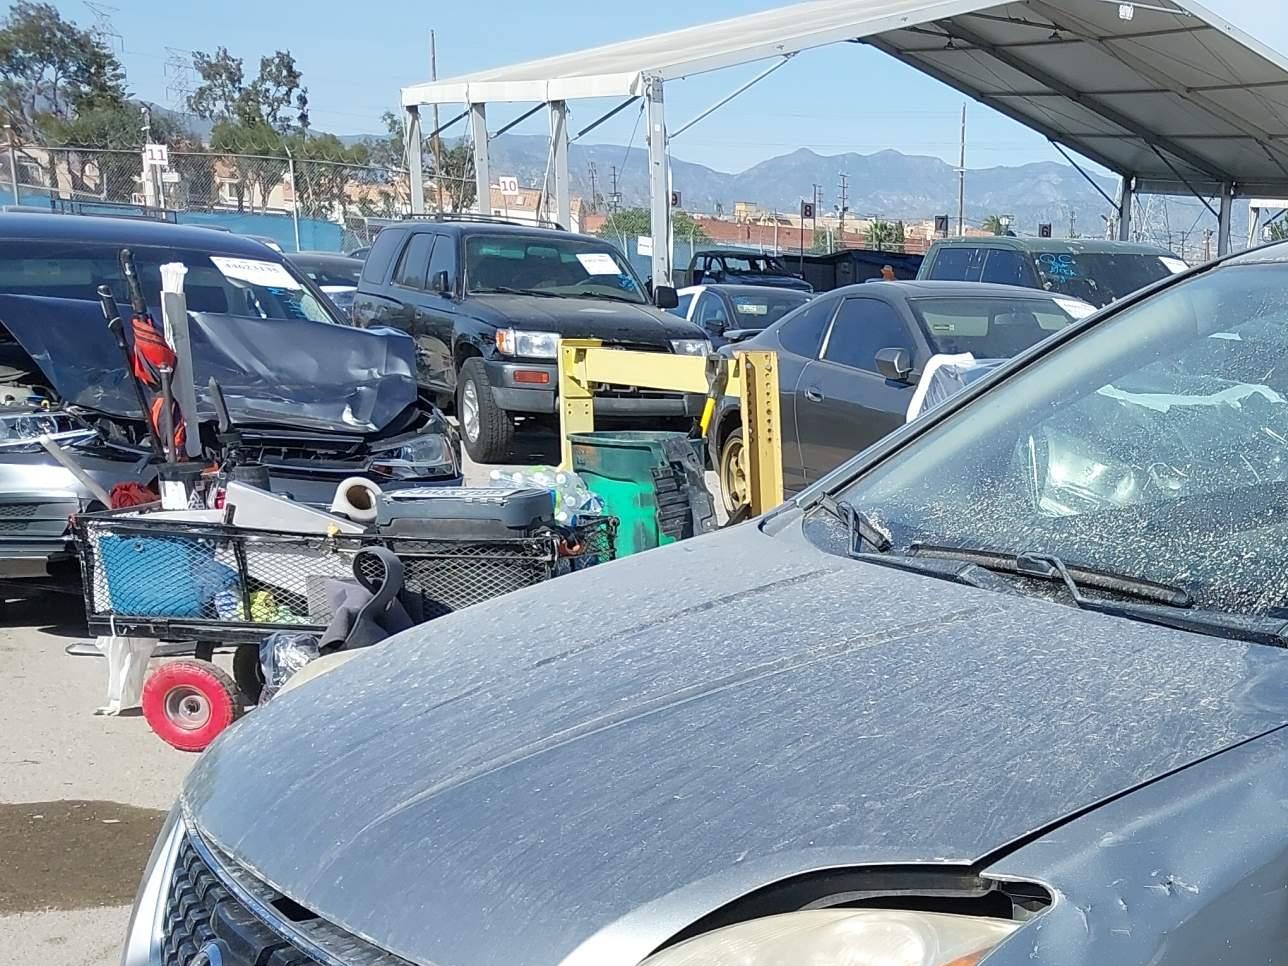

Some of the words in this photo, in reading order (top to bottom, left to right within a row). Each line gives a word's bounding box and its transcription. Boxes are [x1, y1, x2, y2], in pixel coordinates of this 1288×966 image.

[148, 149, 167, 161] 11
[500, 180, 516, 191] 10
[804, 205, 812, 218] 8
[937, 218, 945, 230] 7
[1041, 226, 1049, 237] 6
